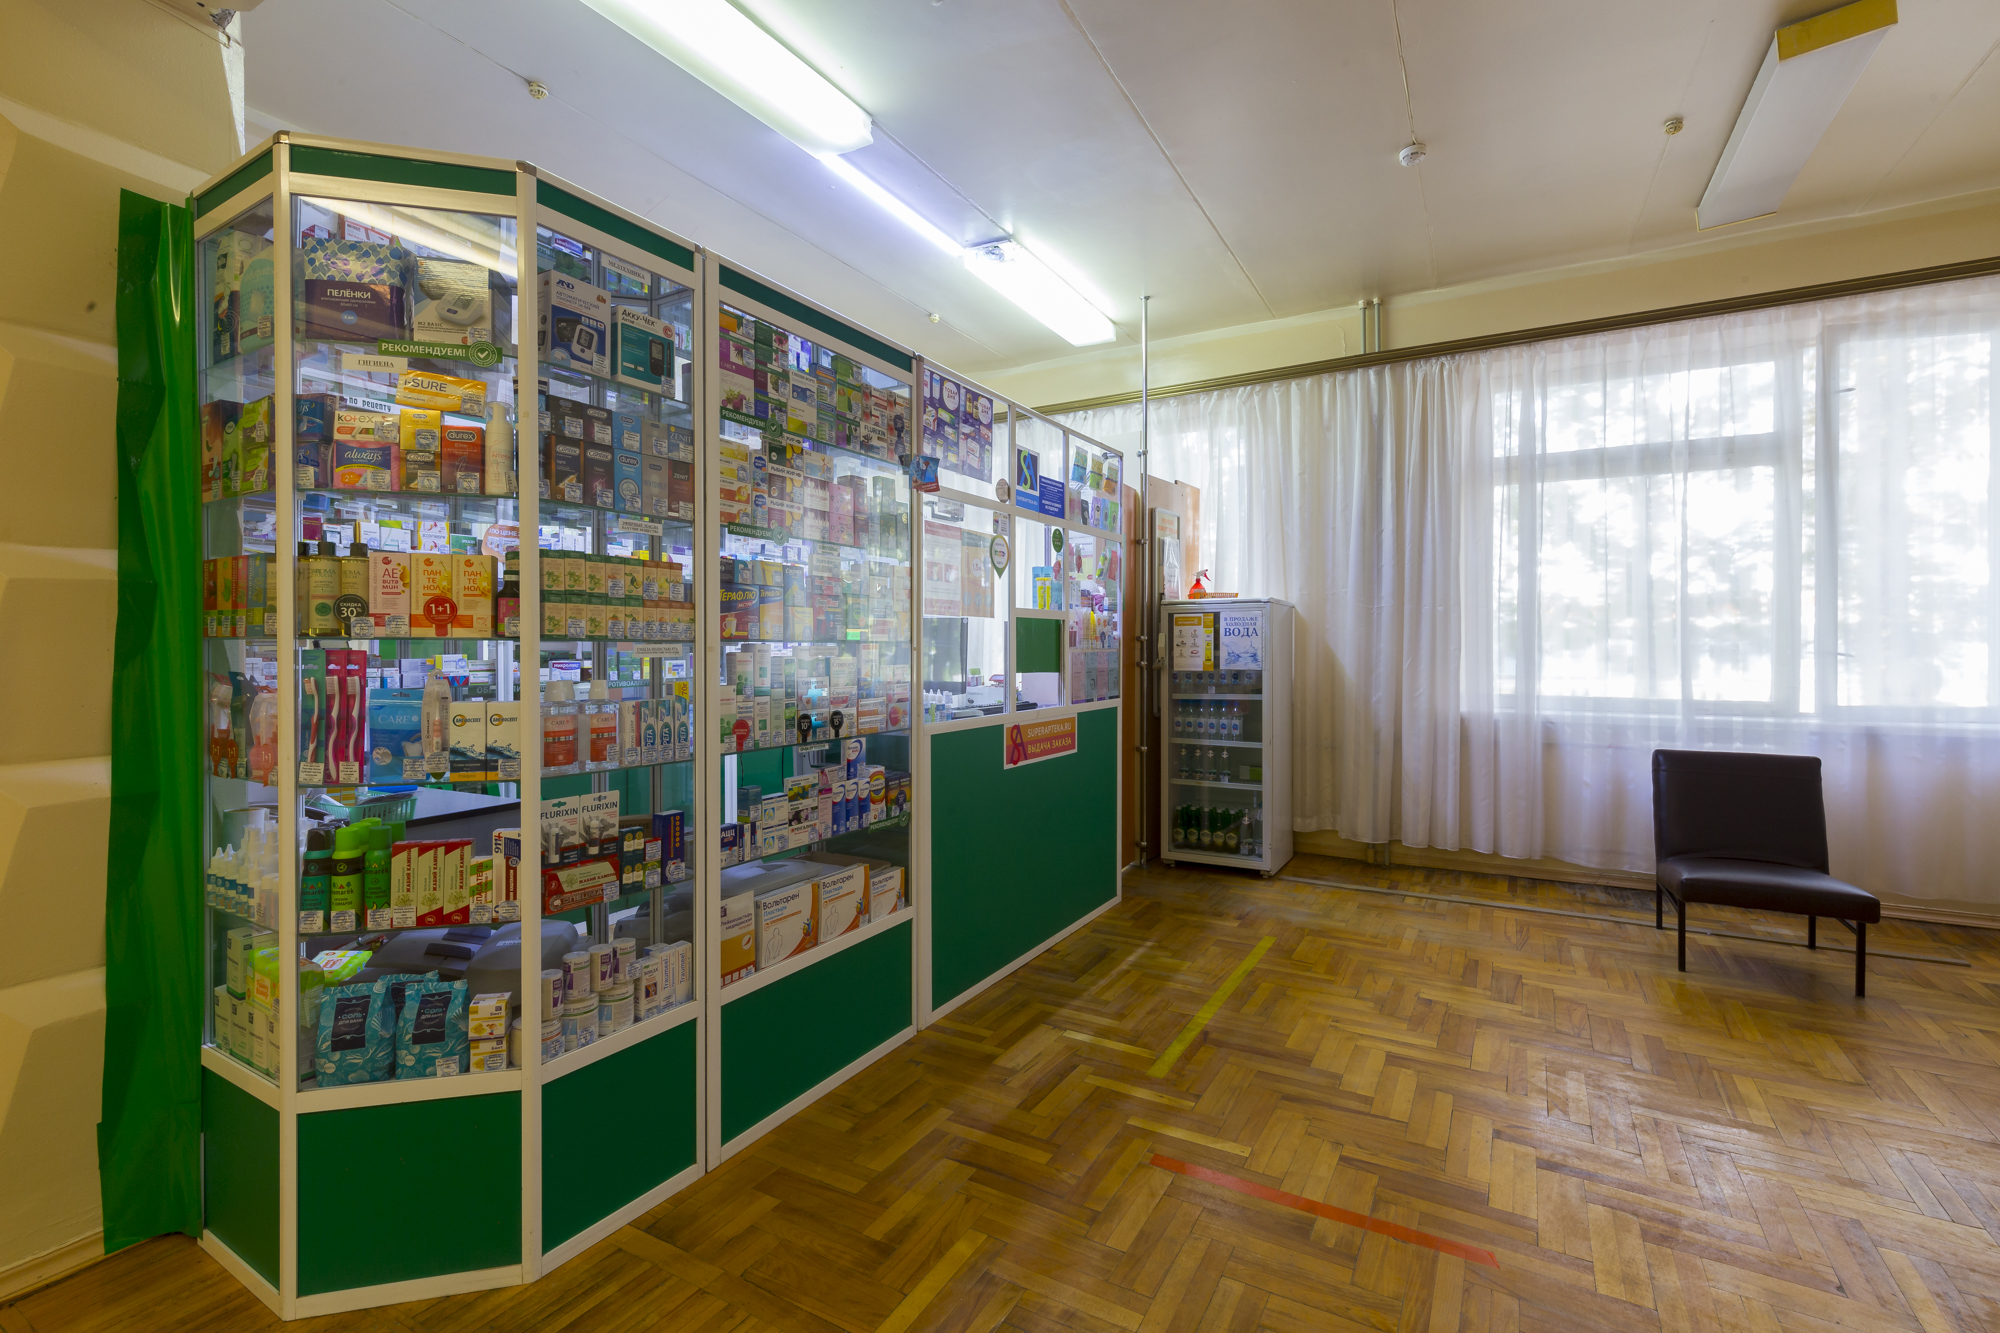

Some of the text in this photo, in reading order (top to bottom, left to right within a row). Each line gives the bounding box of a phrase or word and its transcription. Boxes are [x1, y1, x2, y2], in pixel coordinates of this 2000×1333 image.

[608, 259, 645, 280] МЕДТЕХНИКА
[327, 287, 371, 299] ПЕЛЁНКИ
[556, 290, 600, 310] АВТОМАТИЧЕСКИЙ
[381, 342, 466, 357] РЕКОМЕНДУЕМ!
[357, 358, 395, 368] ГИГИЕНА
[404, 377, 448, 393] i-SURE
[944, 386, 958, 396] ТОВАР
[348, 397, 358, 405] по
[362, 399, 392, 413] рецепту
[978, 402, 991, 411] ТОВАР
[337, 412, 374, 424] kotex
[722, 409, 766, 428] РЕКОМЕНДУЕМ!
[447, 431, 475, 441] durex
[670, 432, 692, 443] ZENIT
[344, 448, 383, 464] always
[619, 455, 639, 466] durex
[673, 473, 689, 481] ZENIT
[729, 525, 772, 538] РЕКОМЕНДУЕМ!
[382, 568, 399, 578] АЕ
[464, 570, 482, 578] ПАН
[720, 589, 757, 601] ТЕРАФЛЮ
[760, 588, 782, 598] ТЕРАФЛЮ
[340, 607, 363, 618] 30%
[429, 603, 451, 614] 1+1
[1224, 627, 1259, 638] ВОДА
[378, 714, 411, 724] CARE
[1027, 722, 1072, 738] SUPERAPTEKA.RU
[211, 744, 220, 755] 1+1
[228, 746, 236, 757] 1+1
[1027, 737, 1072, 754] ВЫДАЧА ЗАКАЗА
[262, 751, 272, 763] 1+1
[581, 801, 618, 814] FLURIXIN
[540, 807, 579, 821] FLURIXIN
[720, 829, 736, 839] АЦЦ
[822, 873, 855, 890] Вольтарен
[871, 874, 895, 887] Вольтарен
[822, 884, 844, 896] Пластырь
[762, 892, 801, 911] Вольтарен
[763, 905, 788, 918] Пластырь
[725, 917, 753, 931] медицинский
